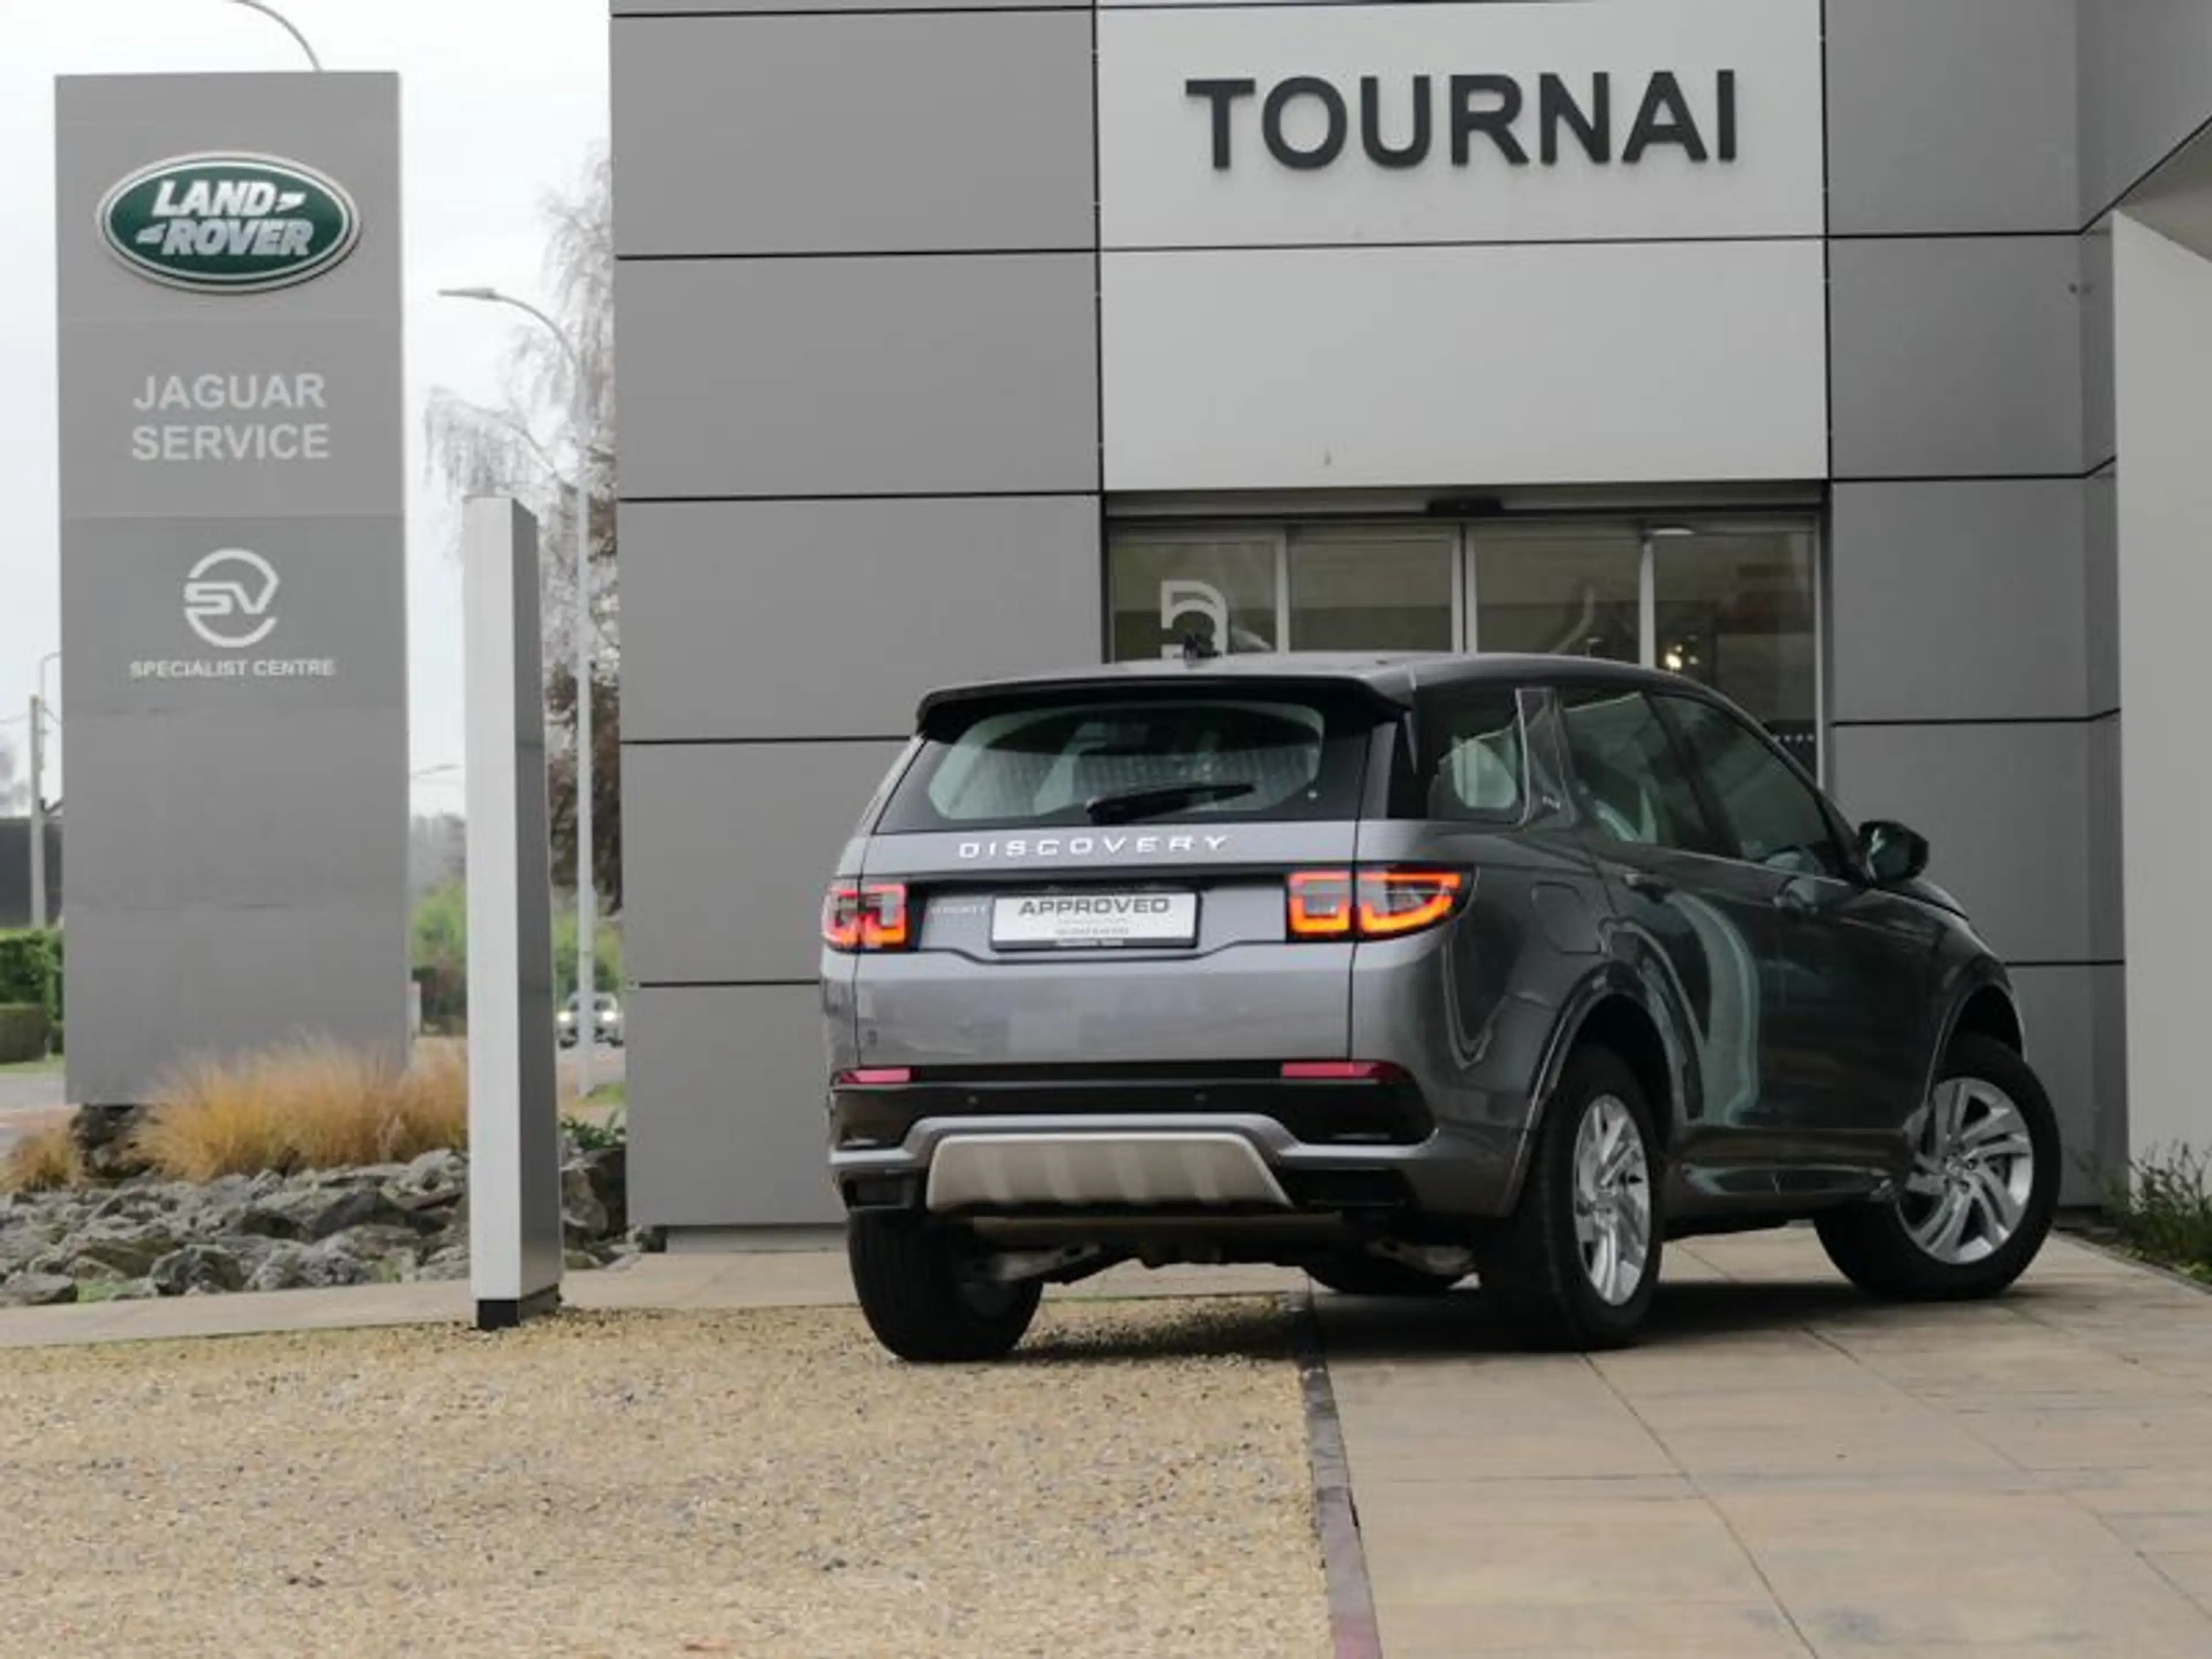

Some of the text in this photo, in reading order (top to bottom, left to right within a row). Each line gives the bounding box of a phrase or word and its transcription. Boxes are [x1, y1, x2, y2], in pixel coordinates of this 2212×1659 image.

[1185, 69, 1737, 172] TOURNAI
[153, 180, 277, 216] LAND
[161, 219, 315, 256] ROVER
[133, 373, 326, 411] JAGUAR
[132, 423, 330, 461] SERVICE
[129, 658, 335, 678] SPECIALIST CENTRE
[959, 834, 1229, 859] DISCOVERY
[1018, 897, 1171, 916] APPROVED
